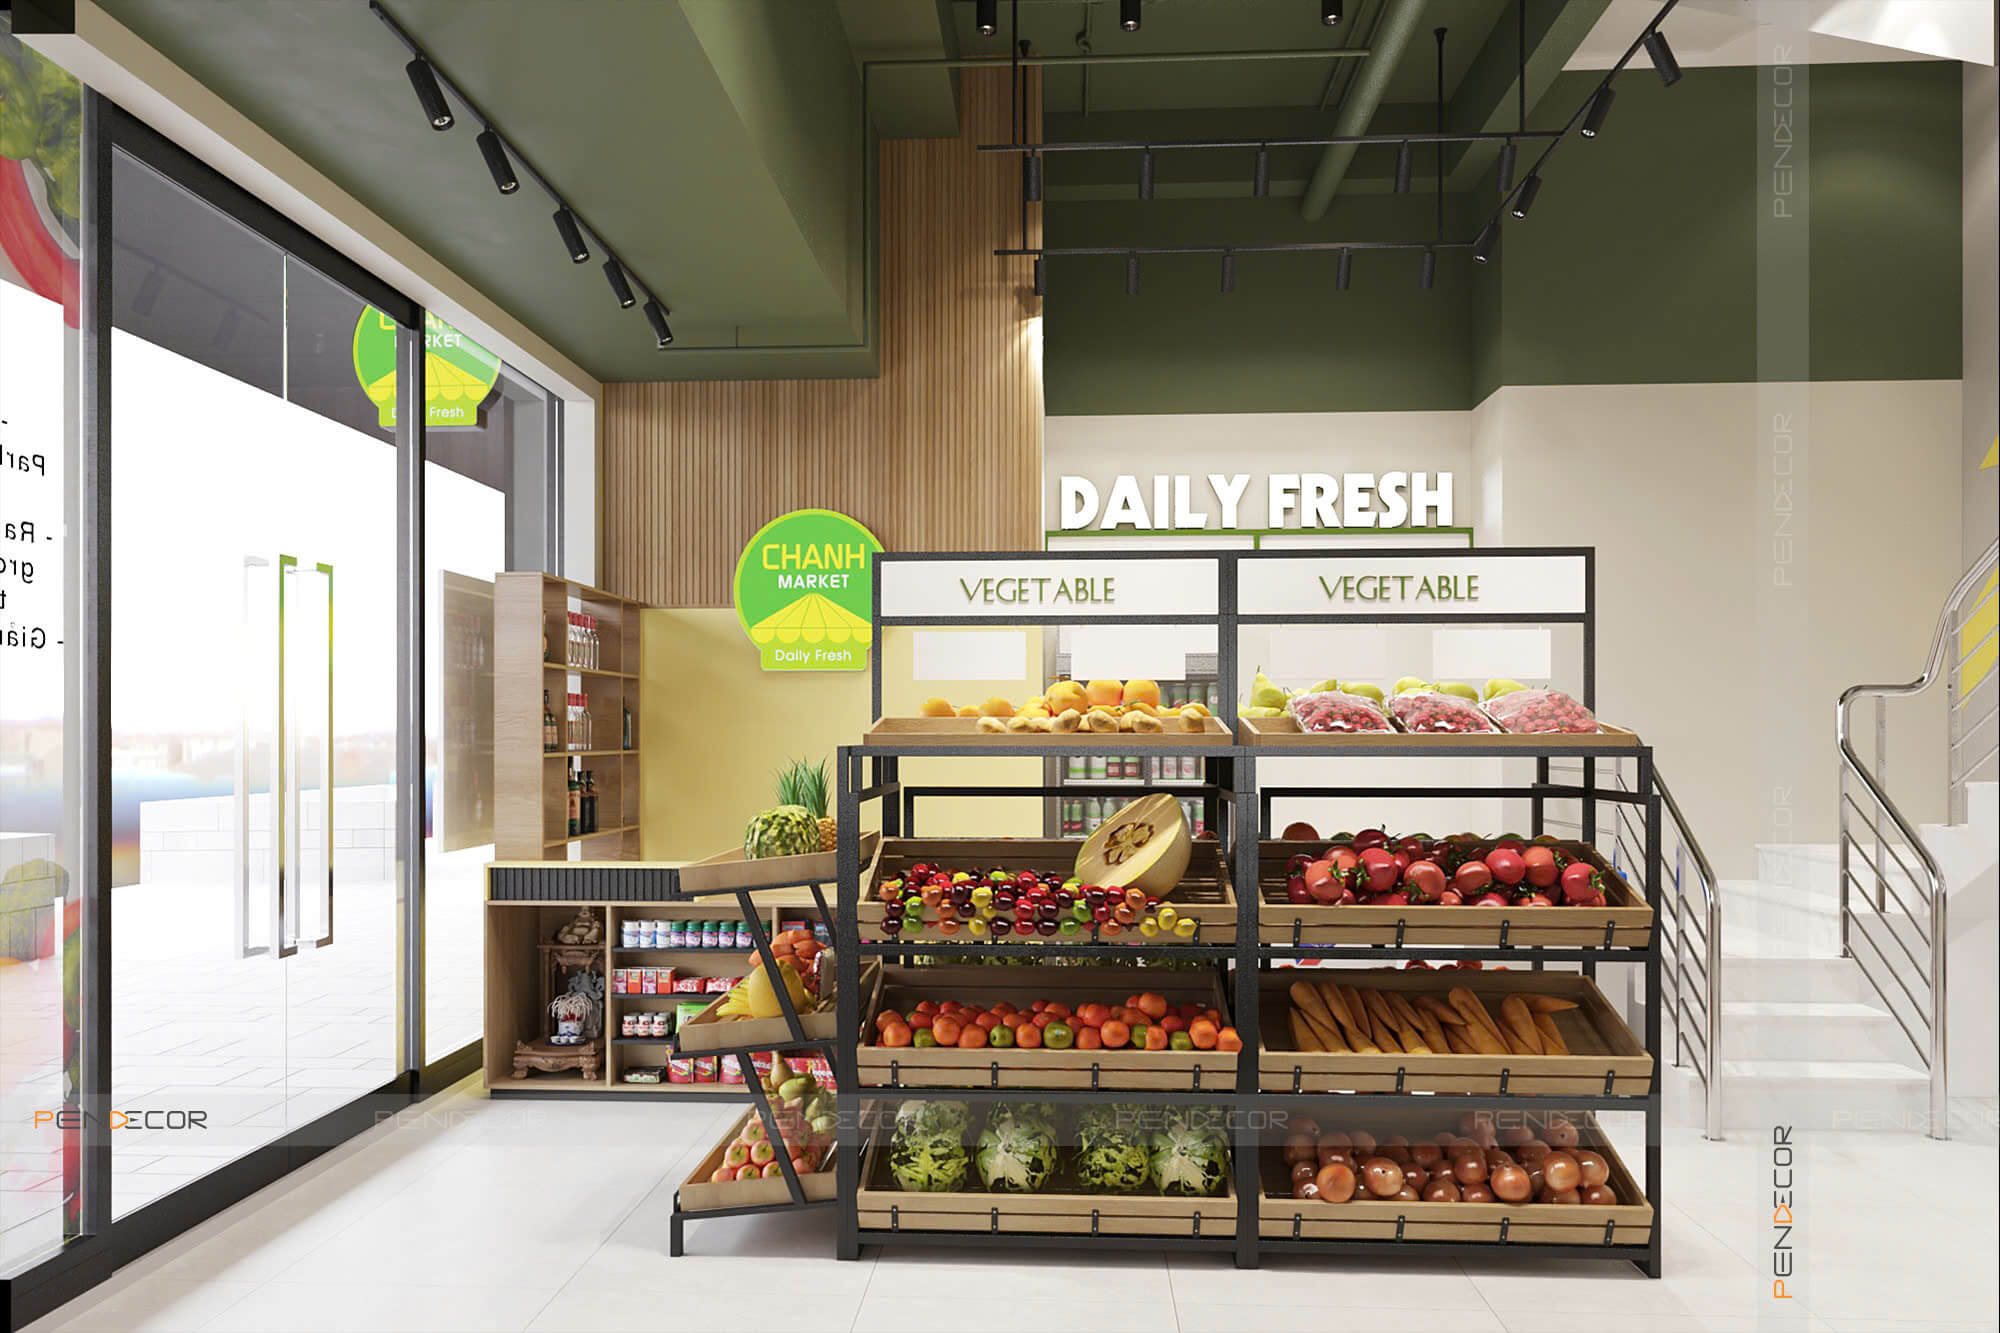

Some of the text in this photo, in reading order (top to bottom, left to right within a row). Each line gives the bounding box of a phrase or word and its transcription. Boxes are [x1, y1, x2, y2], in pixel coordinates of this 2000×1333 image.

[429, 407, 465, 418] Fresh
[1060, 471, 1453, 530] DAILY FRESH
[762, 543, 865, 570] CHANH
[778, 574, 850, 589] MARKET
[959, 577, 1115, 602] VEGETABLE
[1319, 575, 1480, 601] VEGETABLE
[775, 649, 852, 664] Daily Fresh
